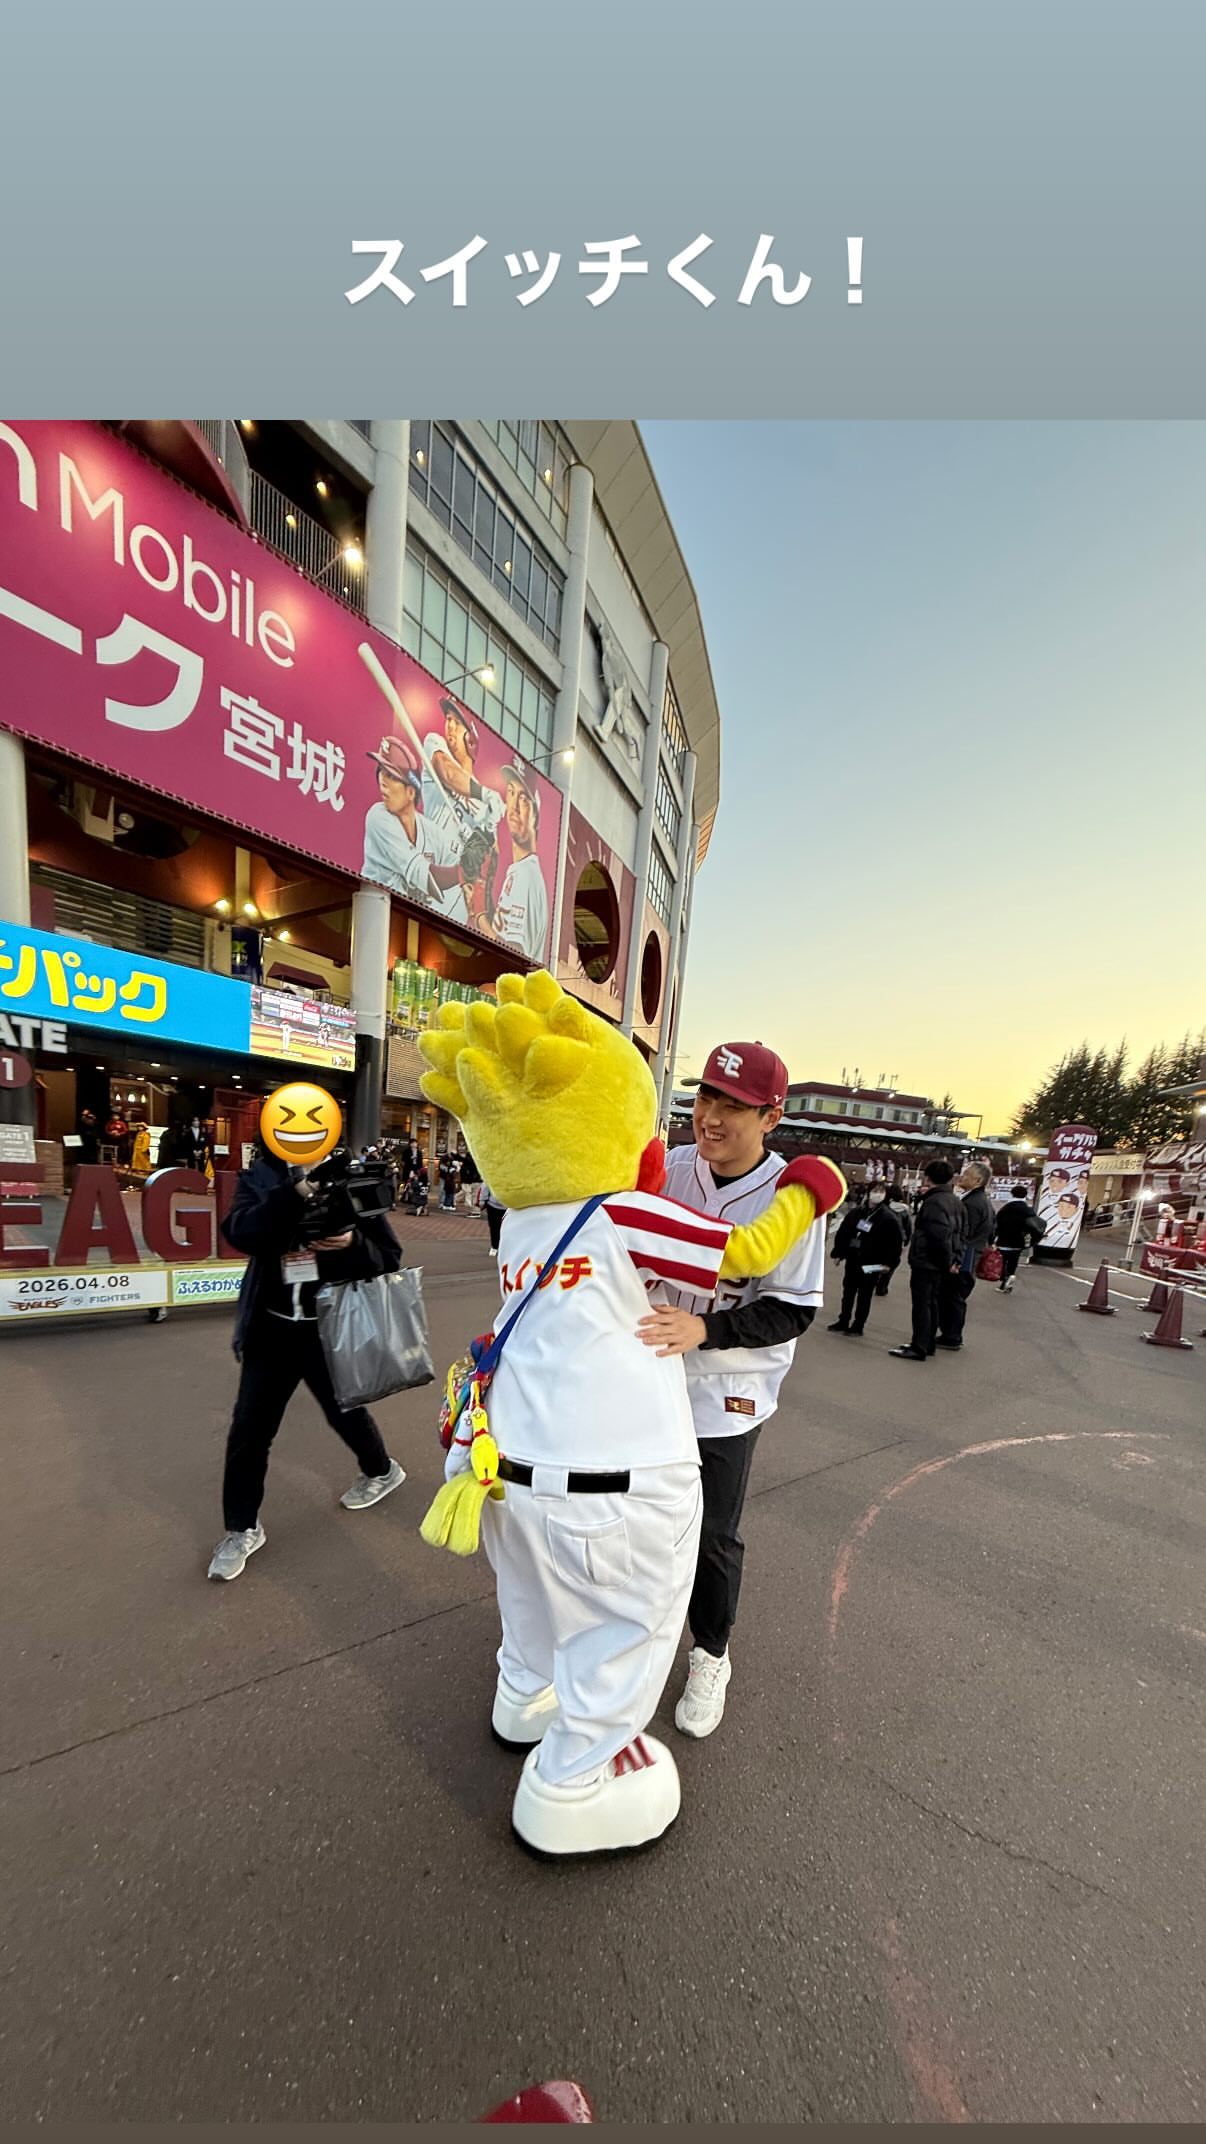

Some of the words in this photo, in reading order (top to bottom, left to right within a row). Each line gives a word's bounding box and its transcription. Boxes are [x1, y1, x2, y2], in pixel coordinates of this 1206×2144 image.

[60, 452, 295, 668] Mobile
[0, 939, 167, 1022] パック
[1, 1057, 14, 1081] 1
[18, 1276, 130, 1294] 2026.04.08
[89, 1293, 141, 1304] FIGHTERS
